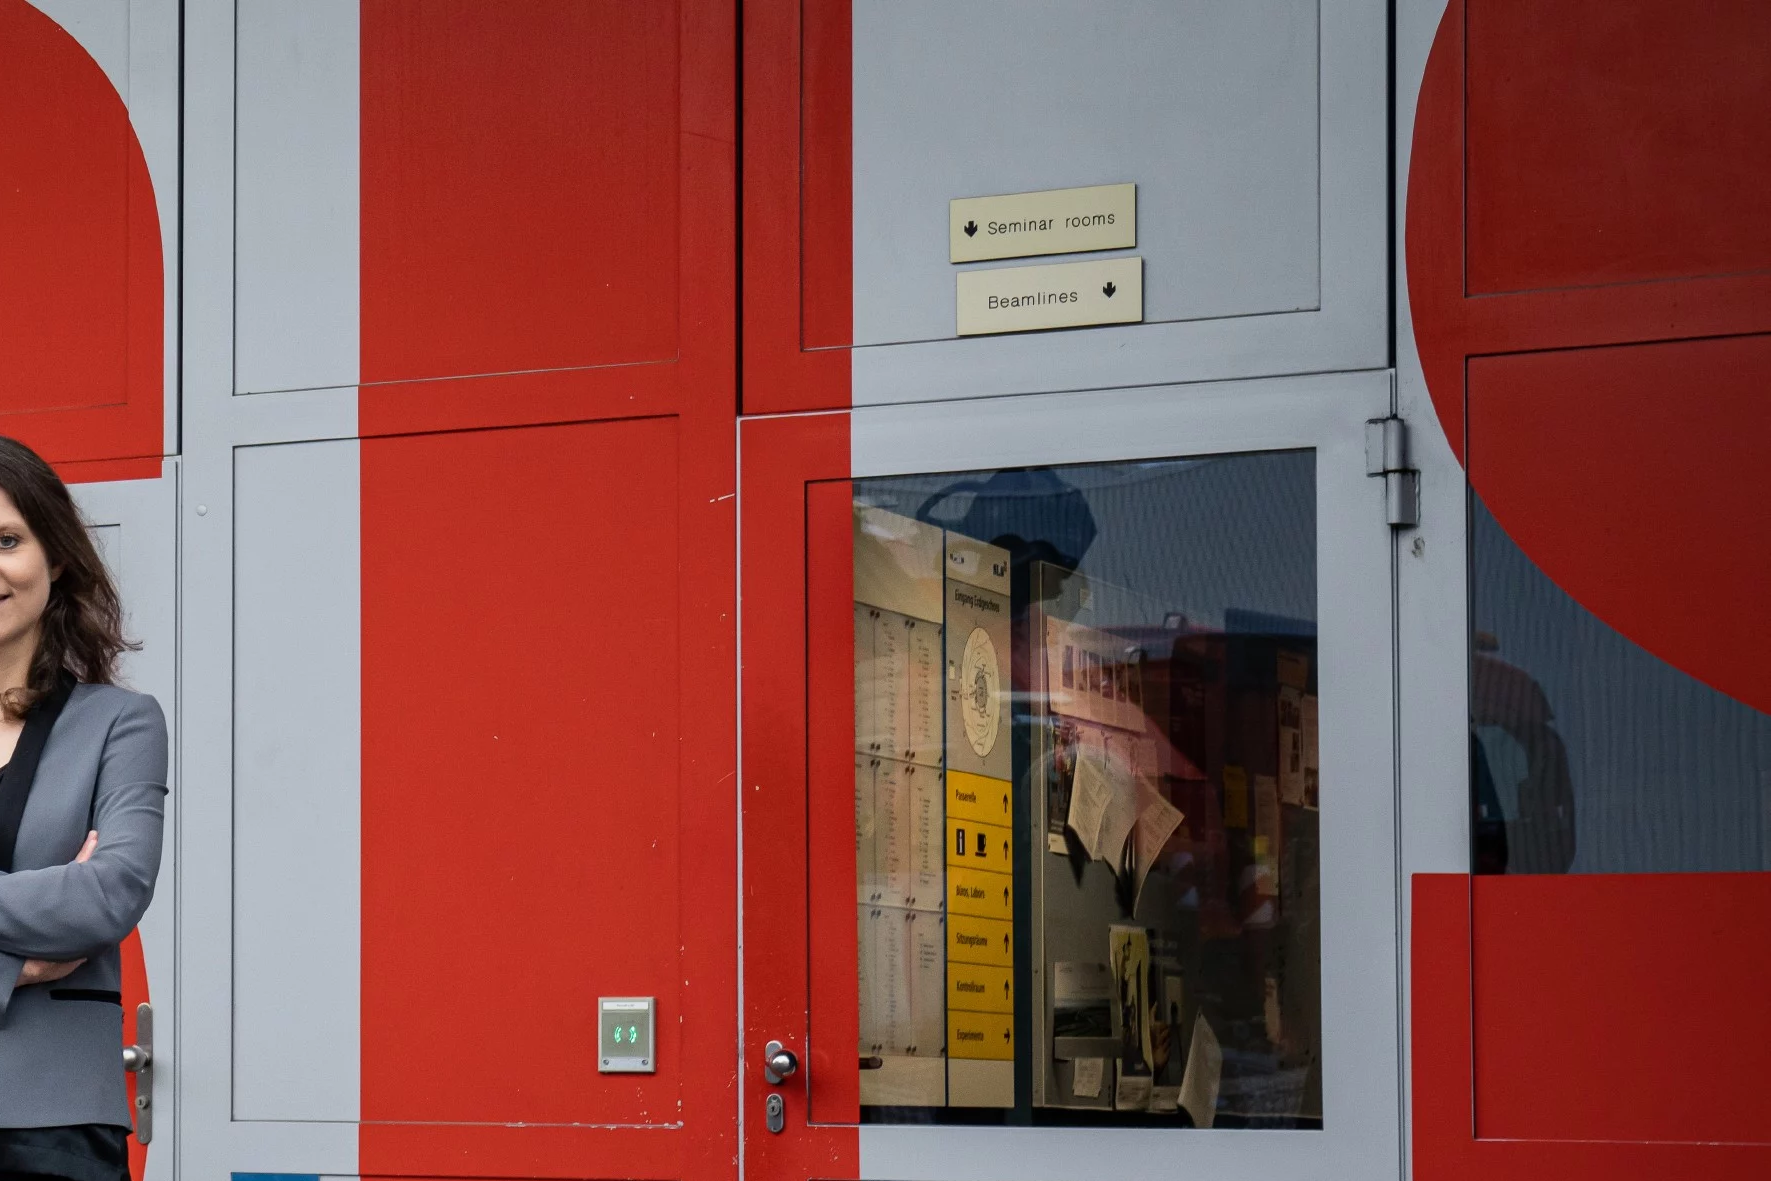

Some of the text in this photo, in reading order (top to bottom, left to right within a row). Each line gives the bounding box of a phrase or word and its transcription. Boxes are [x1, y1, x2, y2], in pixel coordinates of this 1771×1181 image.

[987, 213, 1115, 235] Seminar rooms
[988, 291, 1078, 309] Beamlines
